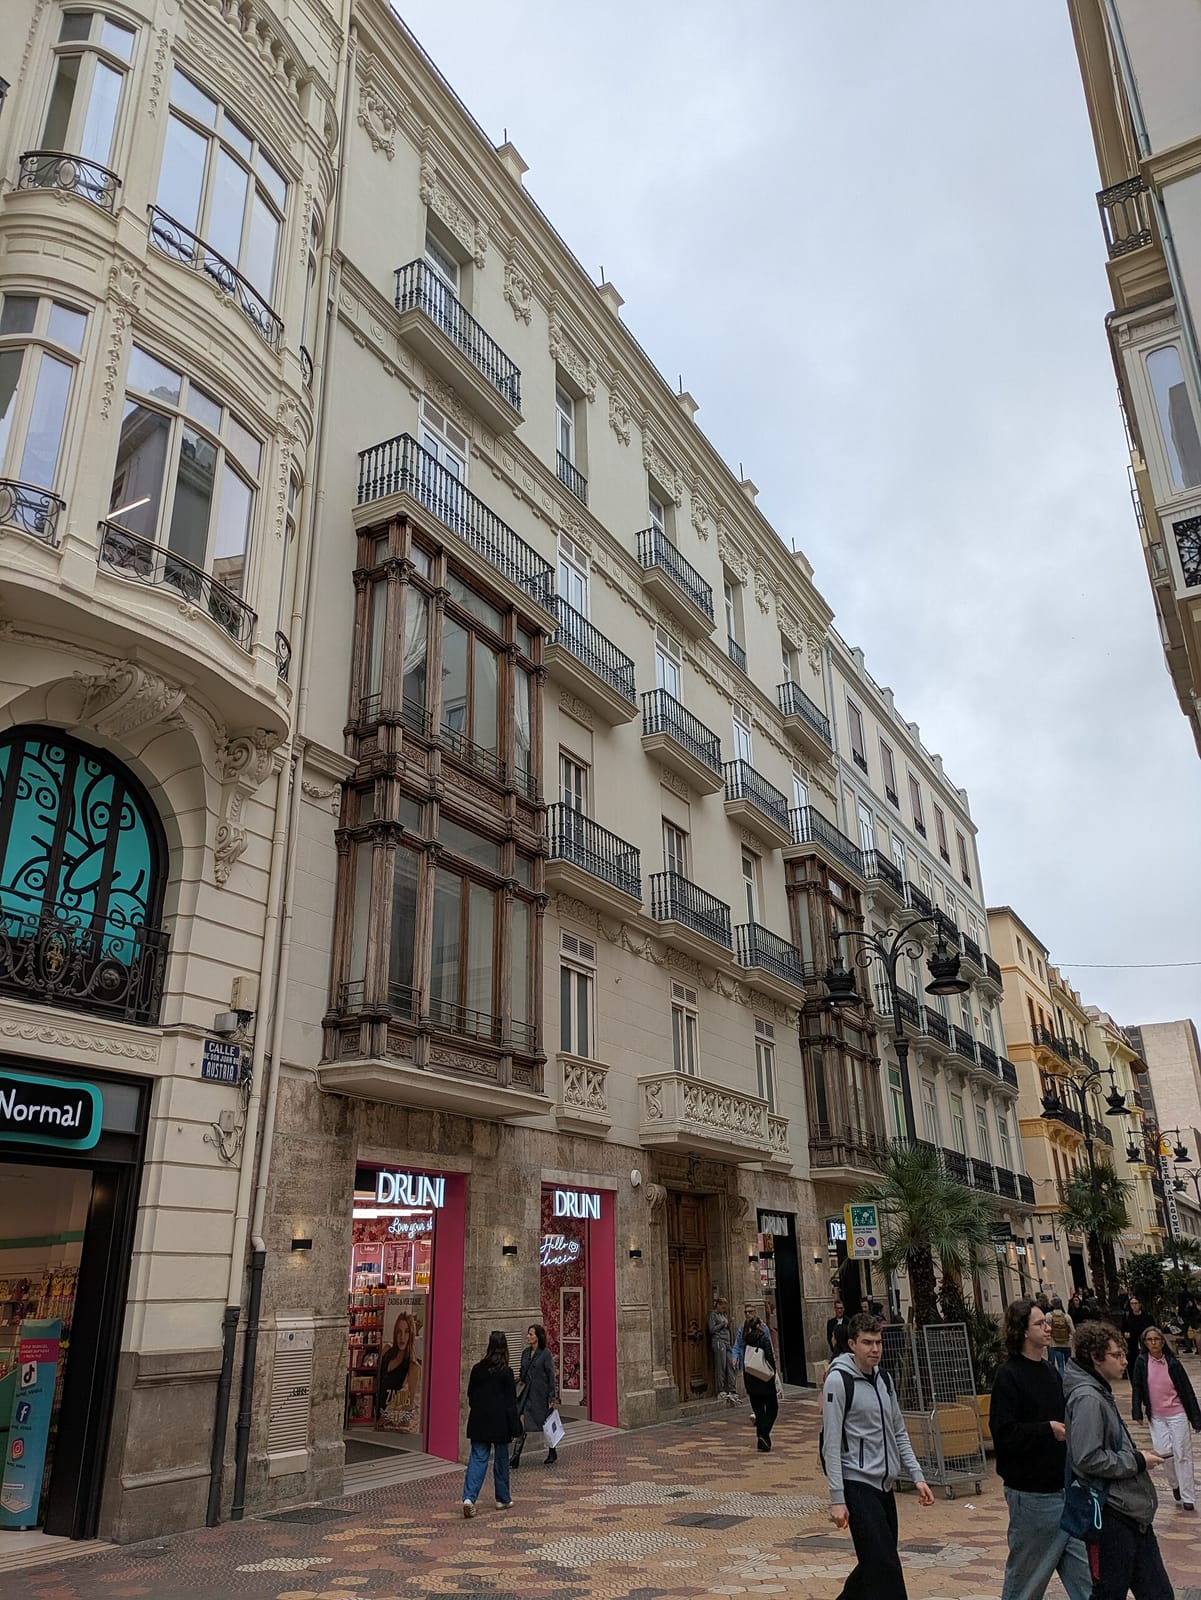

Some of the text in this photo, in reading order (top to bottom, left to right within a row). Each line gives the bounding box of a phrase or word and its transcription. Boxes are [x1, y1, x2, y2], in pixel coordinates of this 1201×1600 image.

[209, 1042, 236, 1057] CALLE
[206, 1061, 235, 1080] AUSTRIA
[0, 1088, 82, 1127] Normal
[1160, 1154, 1171, 1186] ENTRO
[376, 1172, 446, 1208] DRUNI
[554, 1190, 601, 1219] DRUNI
[760, 1215, 788, 1236] DRUNI
[540, 1236, 568, 1252] Hello
